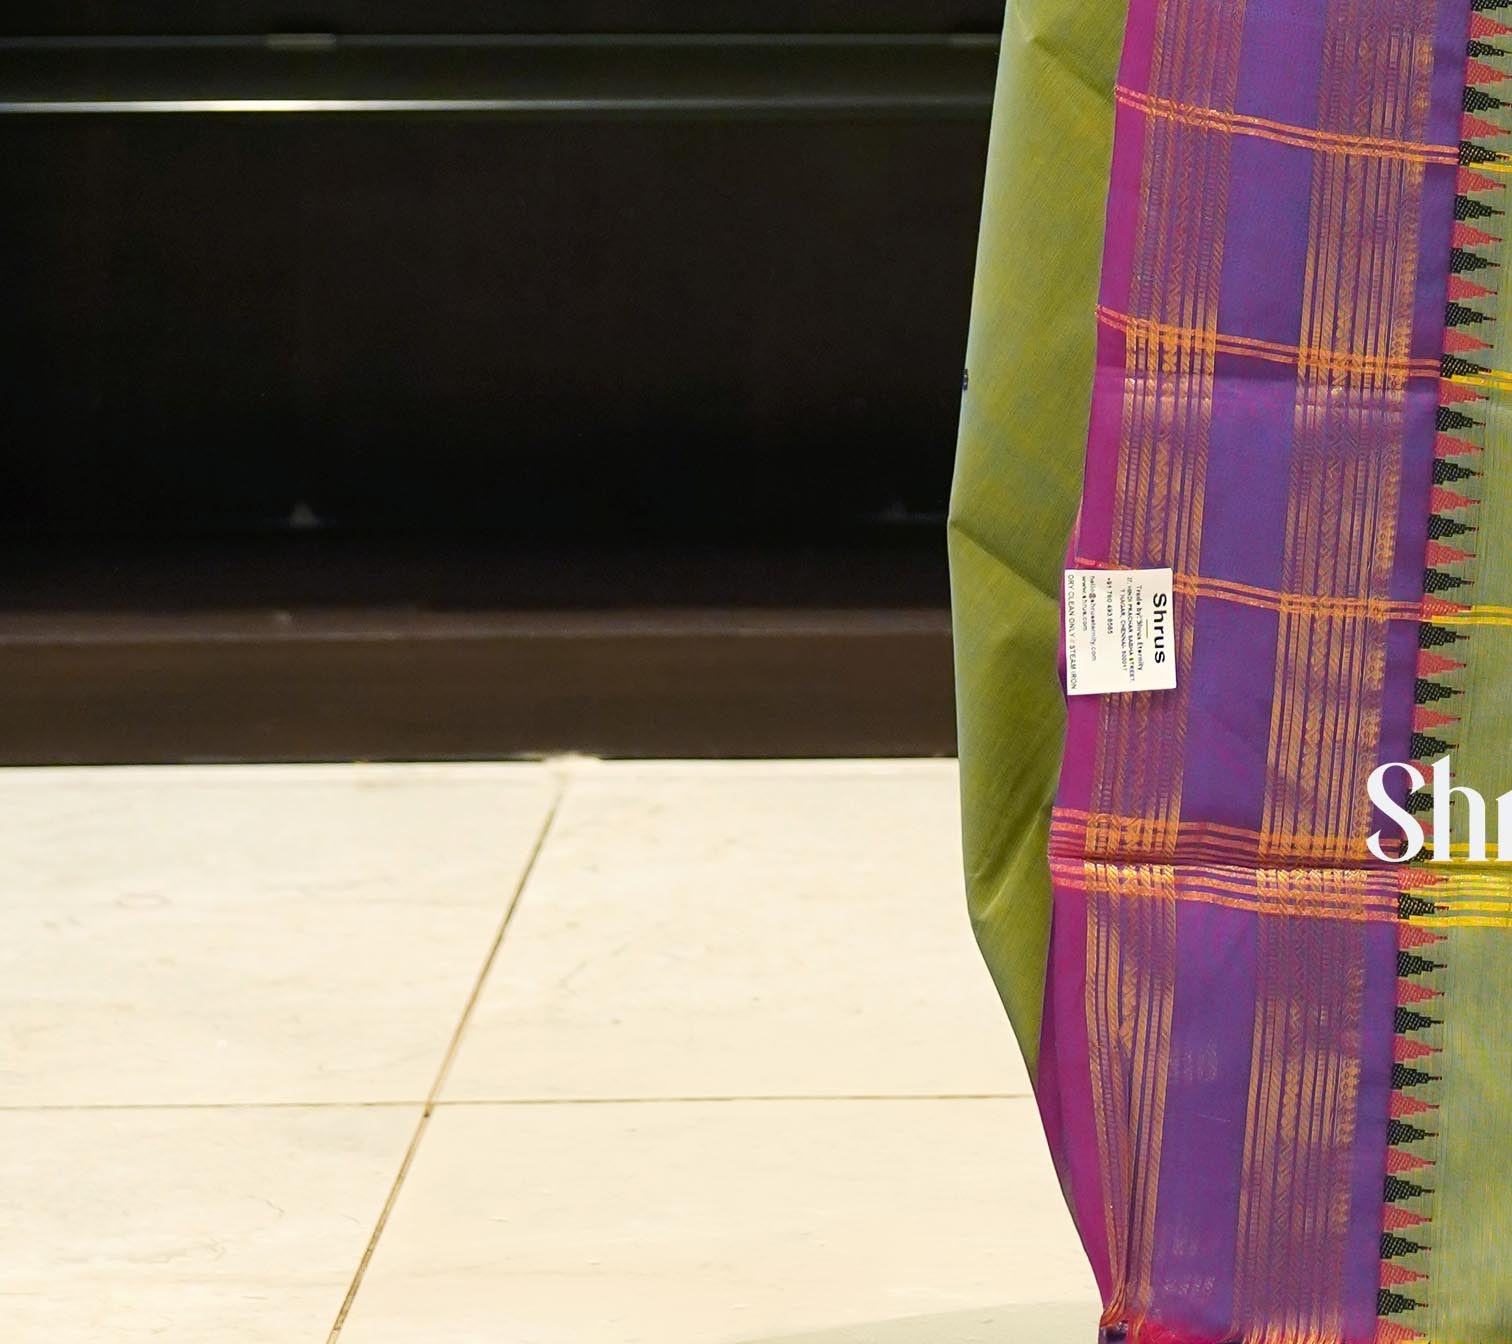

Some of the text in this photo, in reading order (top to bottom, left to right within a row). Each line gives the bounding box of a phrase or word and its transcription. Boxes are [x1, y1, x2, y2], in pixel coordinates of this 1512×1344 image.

[1067, 575, 1075, 590] DRY
[1068, 617, 1076, 638] ONLY
[1153, 593, 1167, 664] Shrus
[1070, 671, 1078, 690] IRON
